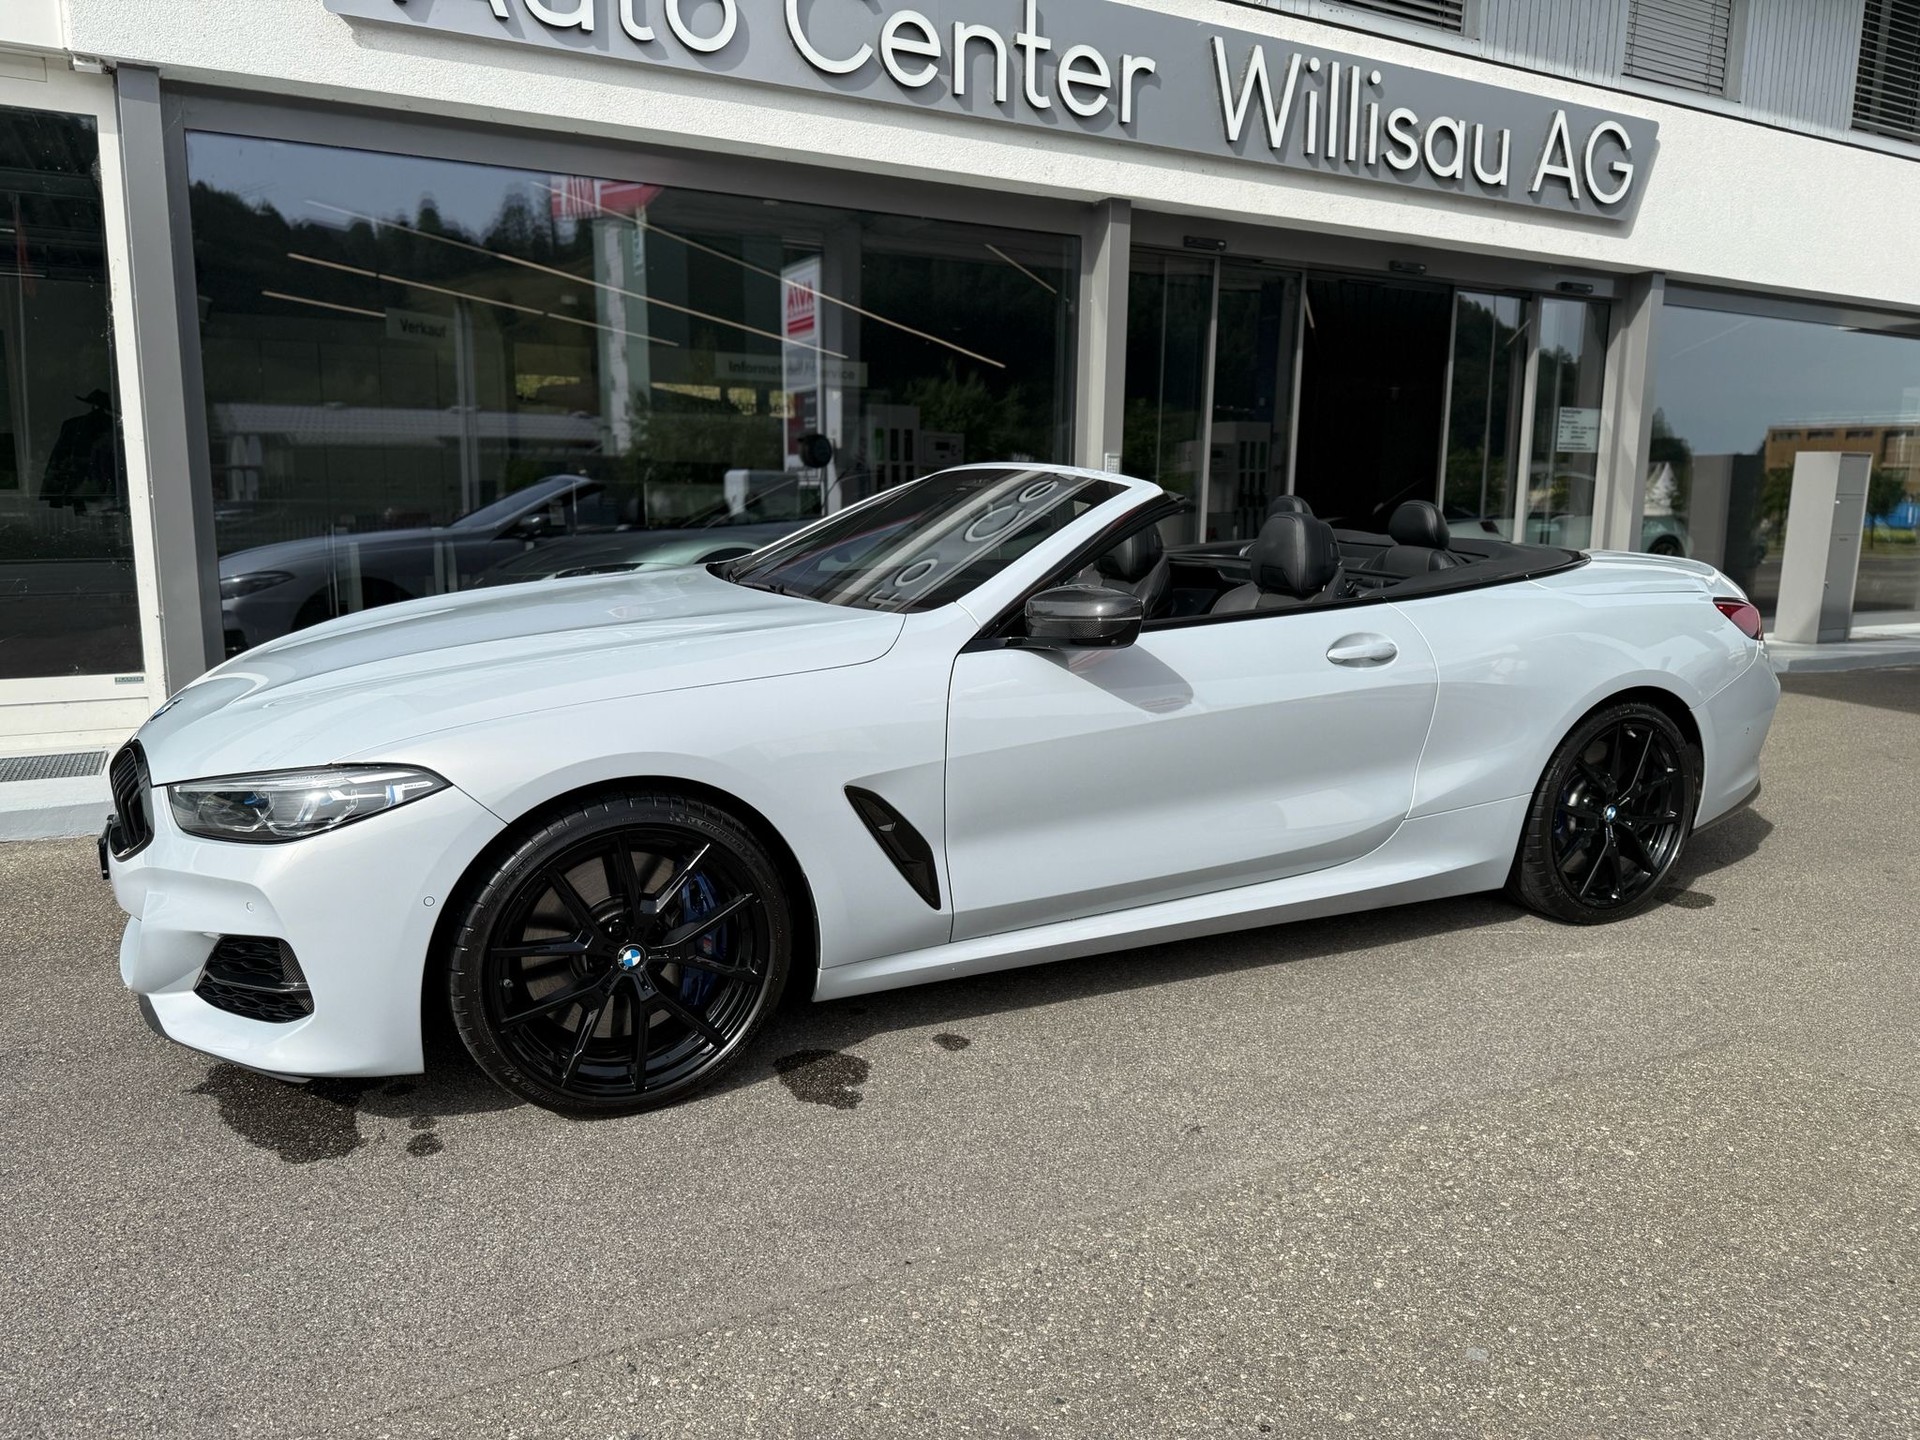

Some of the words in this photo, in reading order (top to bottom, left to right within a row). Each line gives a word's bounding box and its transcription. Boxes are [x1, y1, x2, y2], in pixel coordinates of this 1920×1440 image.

[785, 0, 1157, 125] Center
[1210, 35, 1511, 186] Willisau
[1528, 109, 1635, 205] AG
[400, 318, 447, 338] Verkauf
